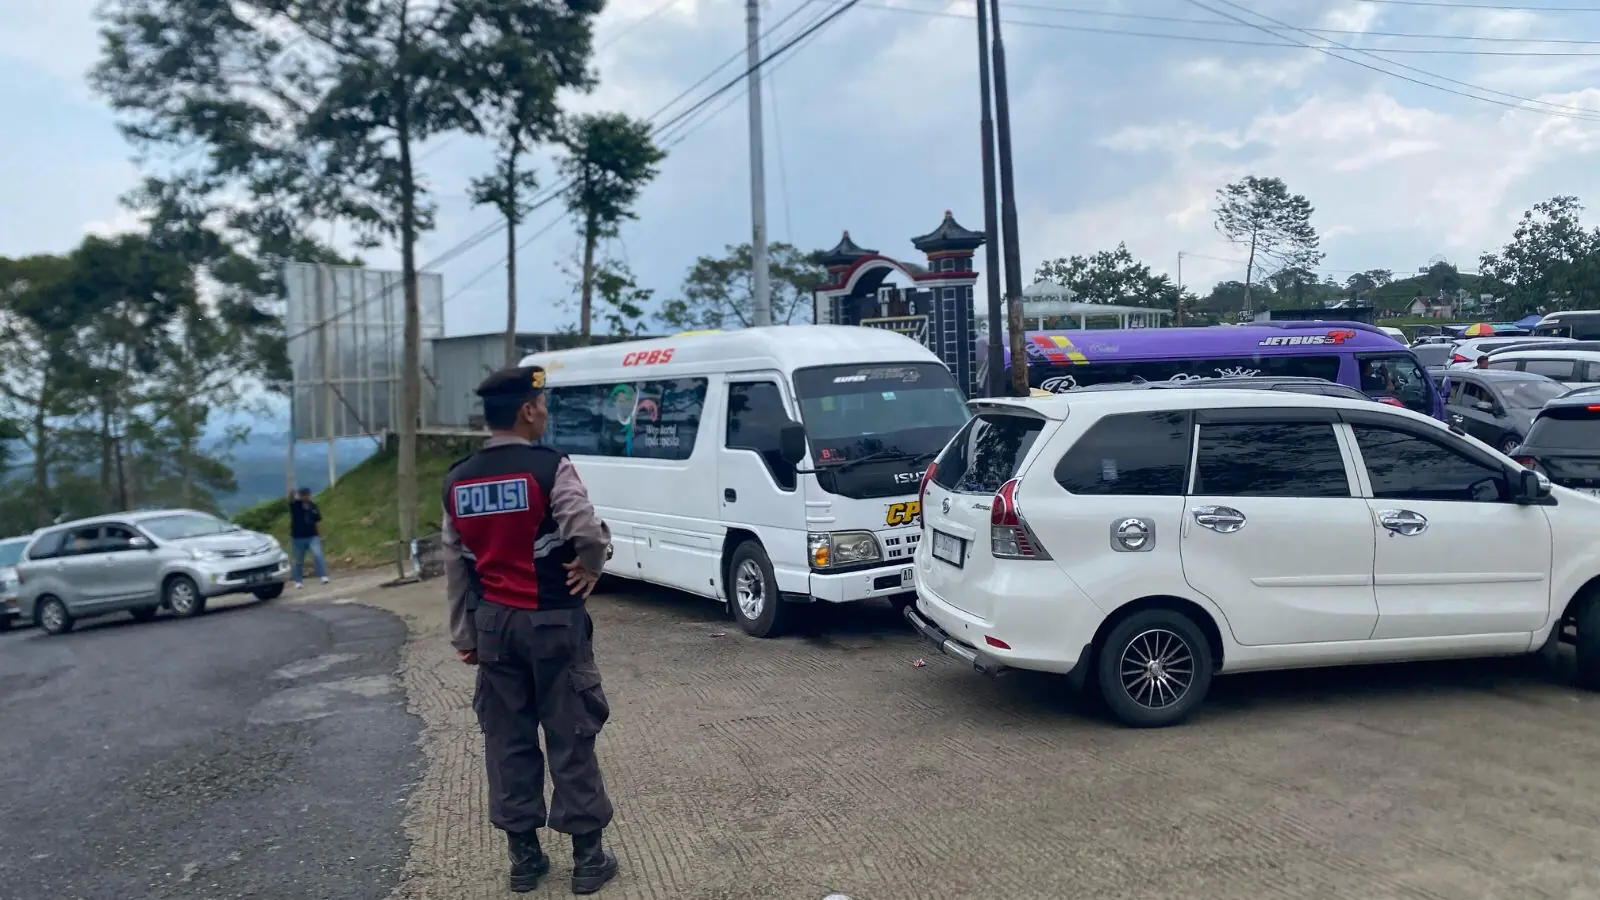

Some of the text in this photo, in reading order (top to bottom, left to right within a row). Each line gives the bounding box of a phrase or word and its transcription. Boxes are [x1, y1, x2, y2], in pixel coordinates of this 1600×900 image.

[1258, 335, 1326, 346] JETBUS
[622, 348, 676, 367] CPBS
[457, 480, 526, 515] POLISI
